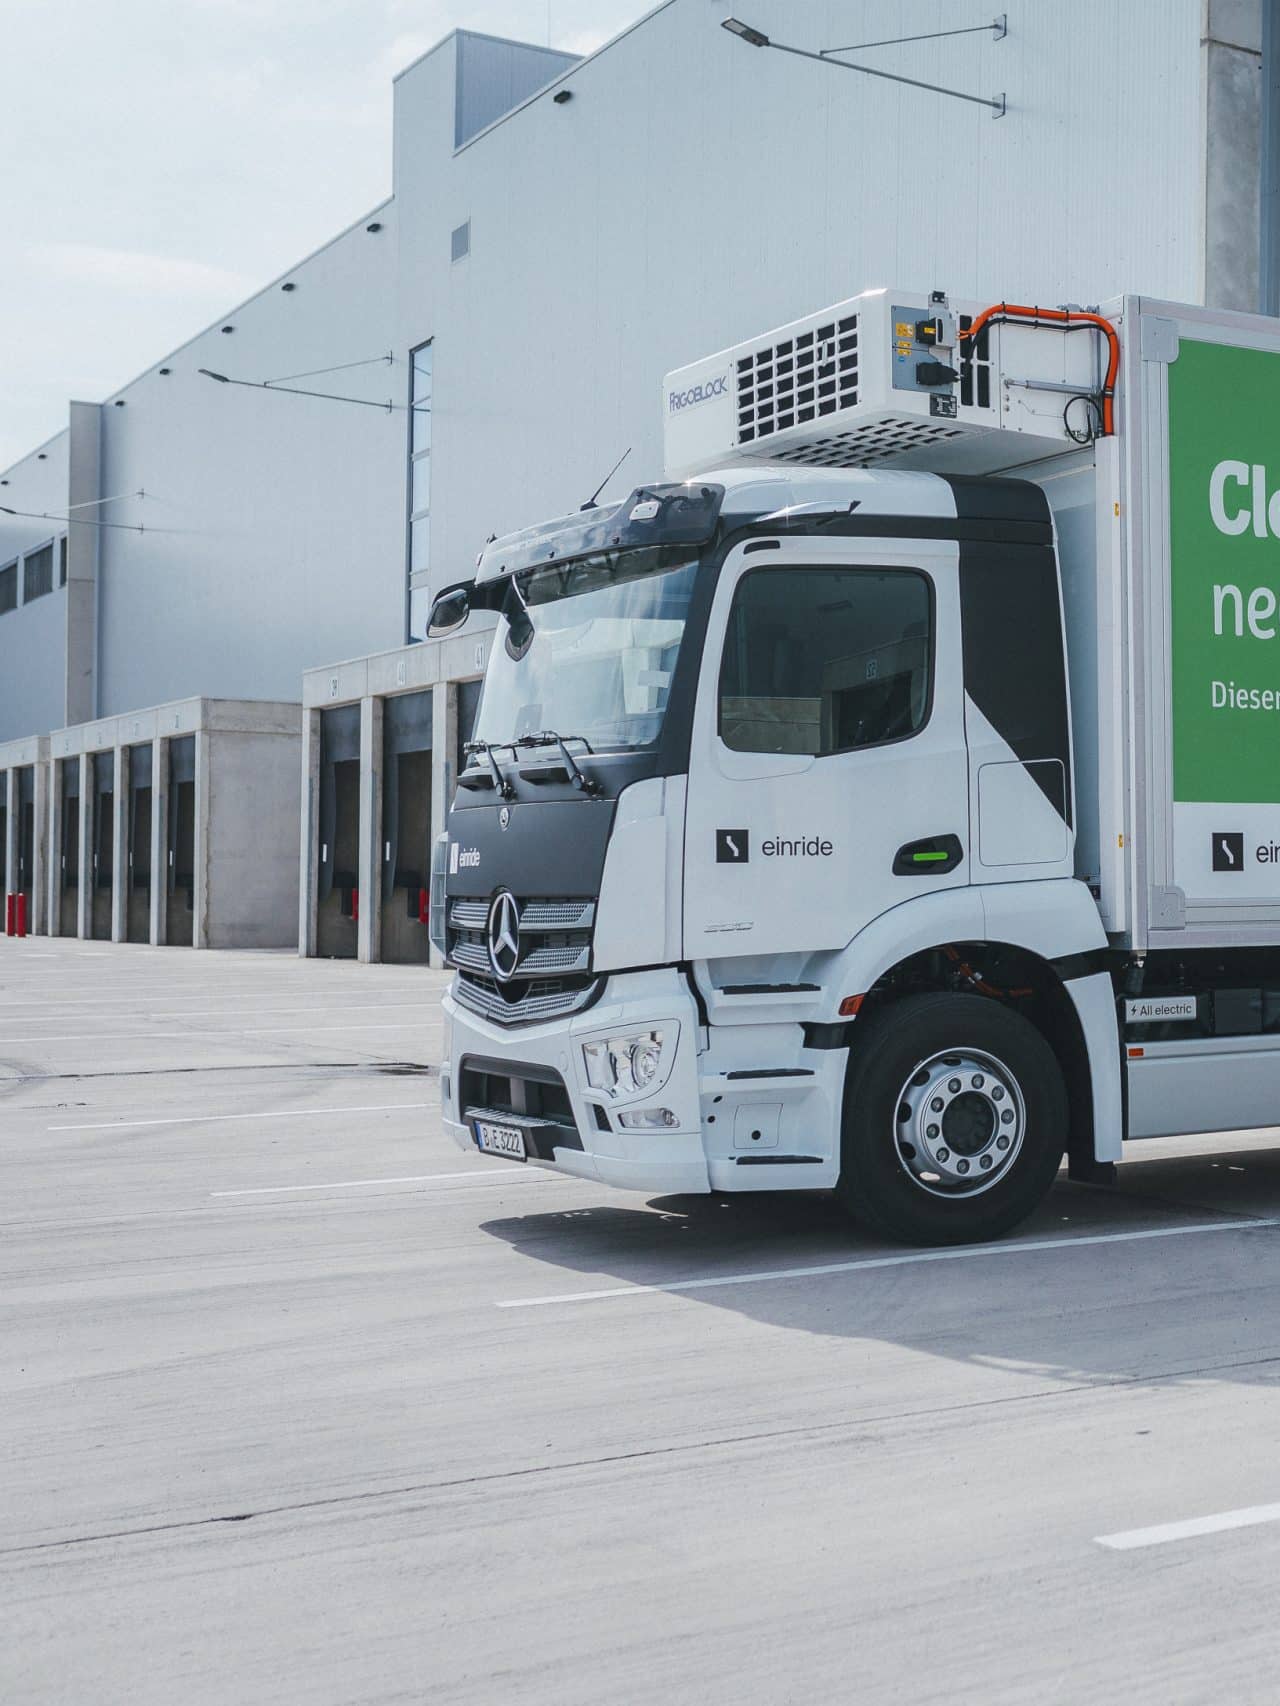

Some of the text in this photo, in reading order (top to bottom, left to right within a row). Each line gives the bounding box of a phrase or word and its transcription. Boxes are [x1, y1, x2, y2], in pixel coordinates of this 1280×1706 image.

[669, 375, 728, 412] FRIGOBLOCK
[761, 836, 833, 857] einride
[460, 848, 480, 867] einride
[1140, 1003, 1192, 1016] All electric
